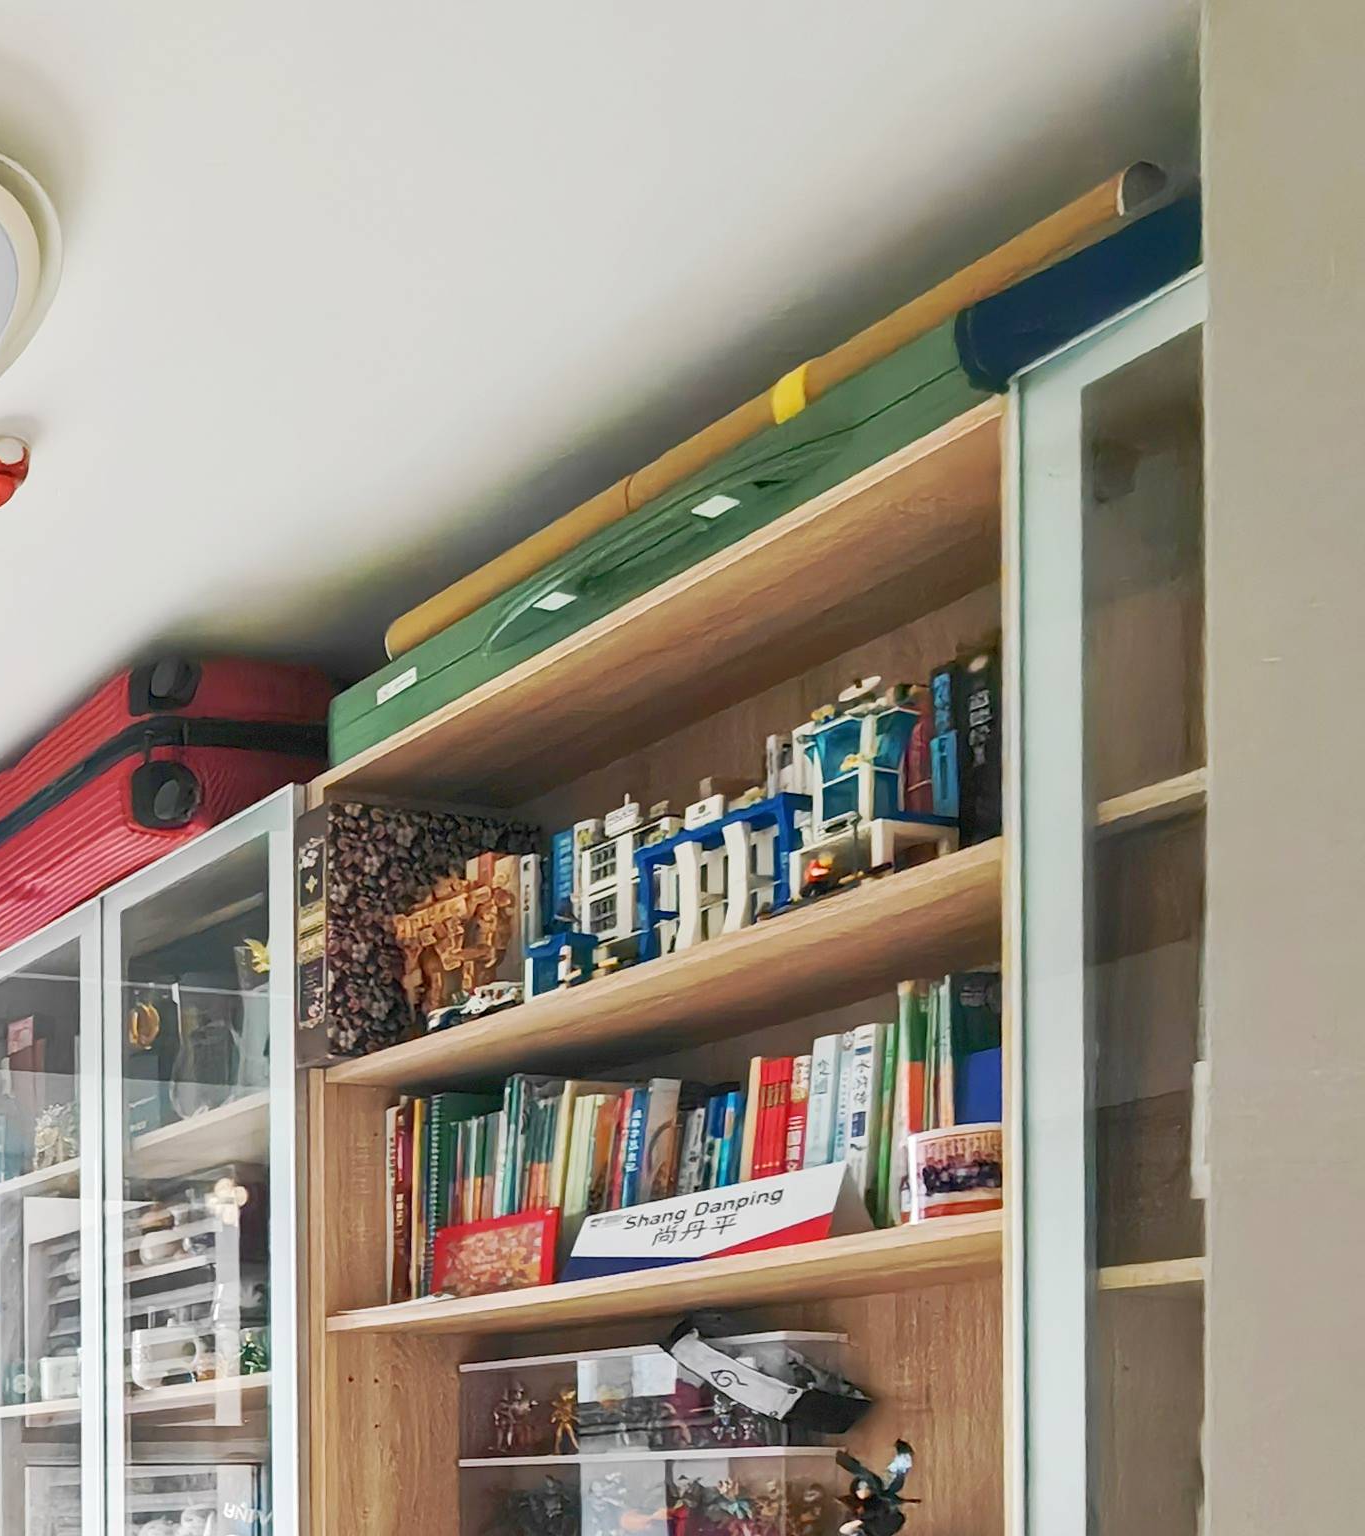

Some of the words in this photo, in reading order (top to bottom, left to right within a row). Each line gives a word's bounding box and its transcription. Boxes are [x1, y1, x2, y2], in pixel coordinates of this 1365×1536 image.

[624, 1208, 687, 1230] Shang
[695, 1188, 784, 1216] Danping
[651, 1212, 738, 1247] 尚丹平
